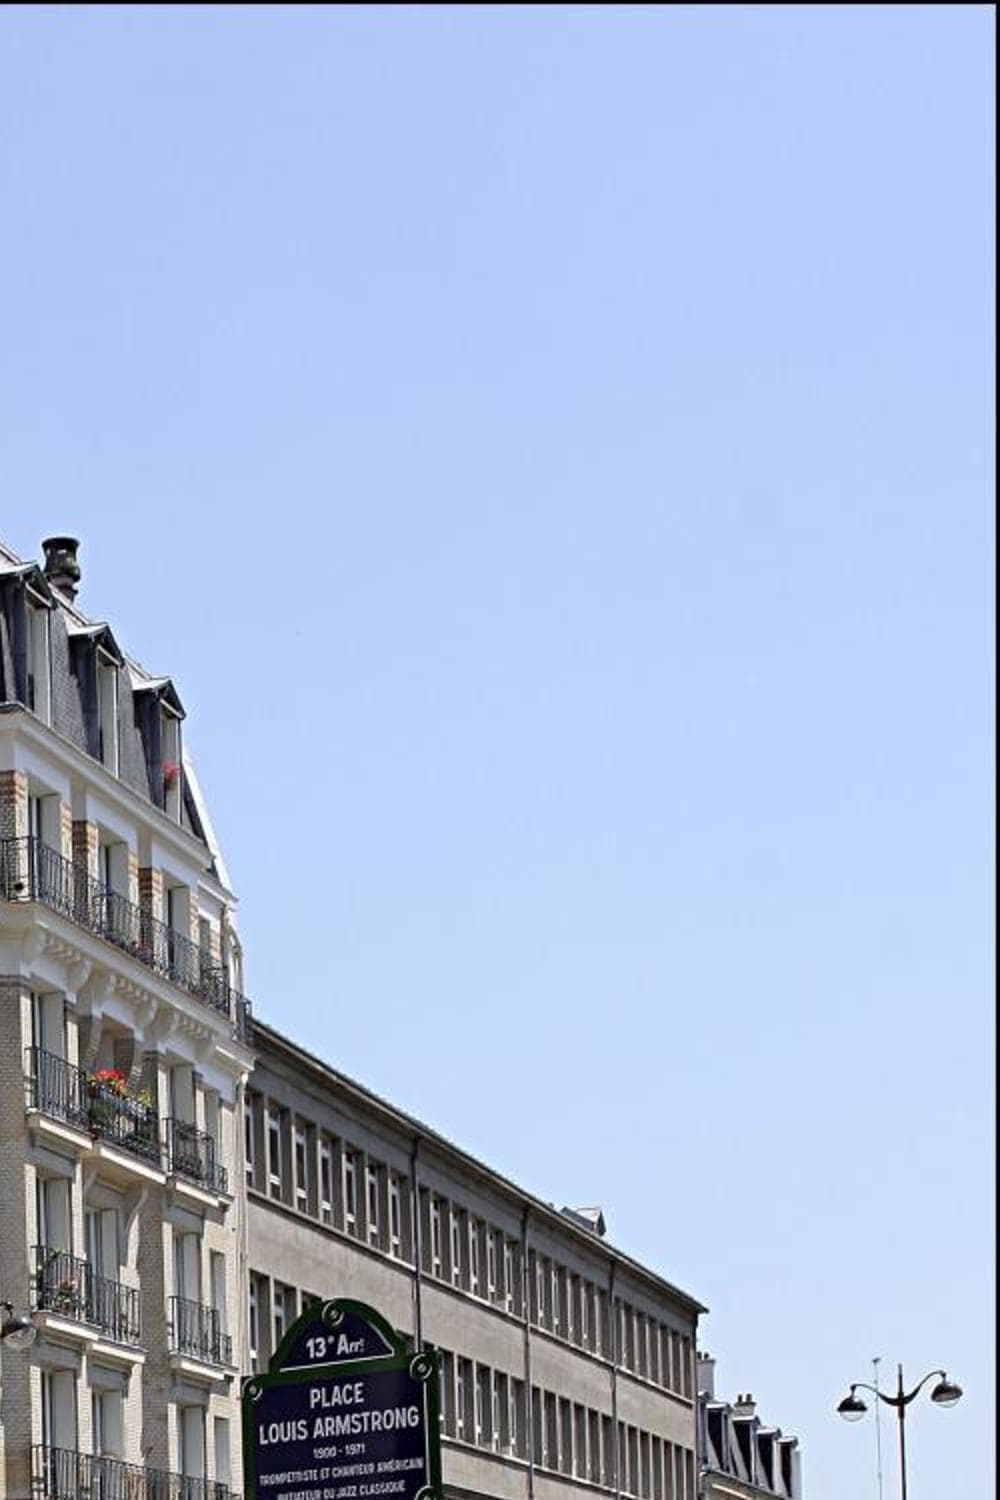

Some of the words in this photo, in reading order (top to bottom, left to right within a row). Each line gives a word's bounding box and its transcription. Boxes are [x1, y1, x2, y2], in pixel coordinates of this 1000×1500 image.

[309, 1382, 365, 1409] PLACE
[259, 1420, 309, 1446] LOUIS
[313, 1406, 420, 1439] ARMSTRONG
[313, 1446, 337, 1459] 1900
[345, 1443, 366, 1457] 1971
[320, 1467, 330, 1480] ET
[331, 1461, 377, 1477] CHANTEUR
[323, 1487, 335, 1500] DU
[336, 1484, 358, 1499] JAZZ
[359, 1479, 406, 1496] CLASSIQUE
